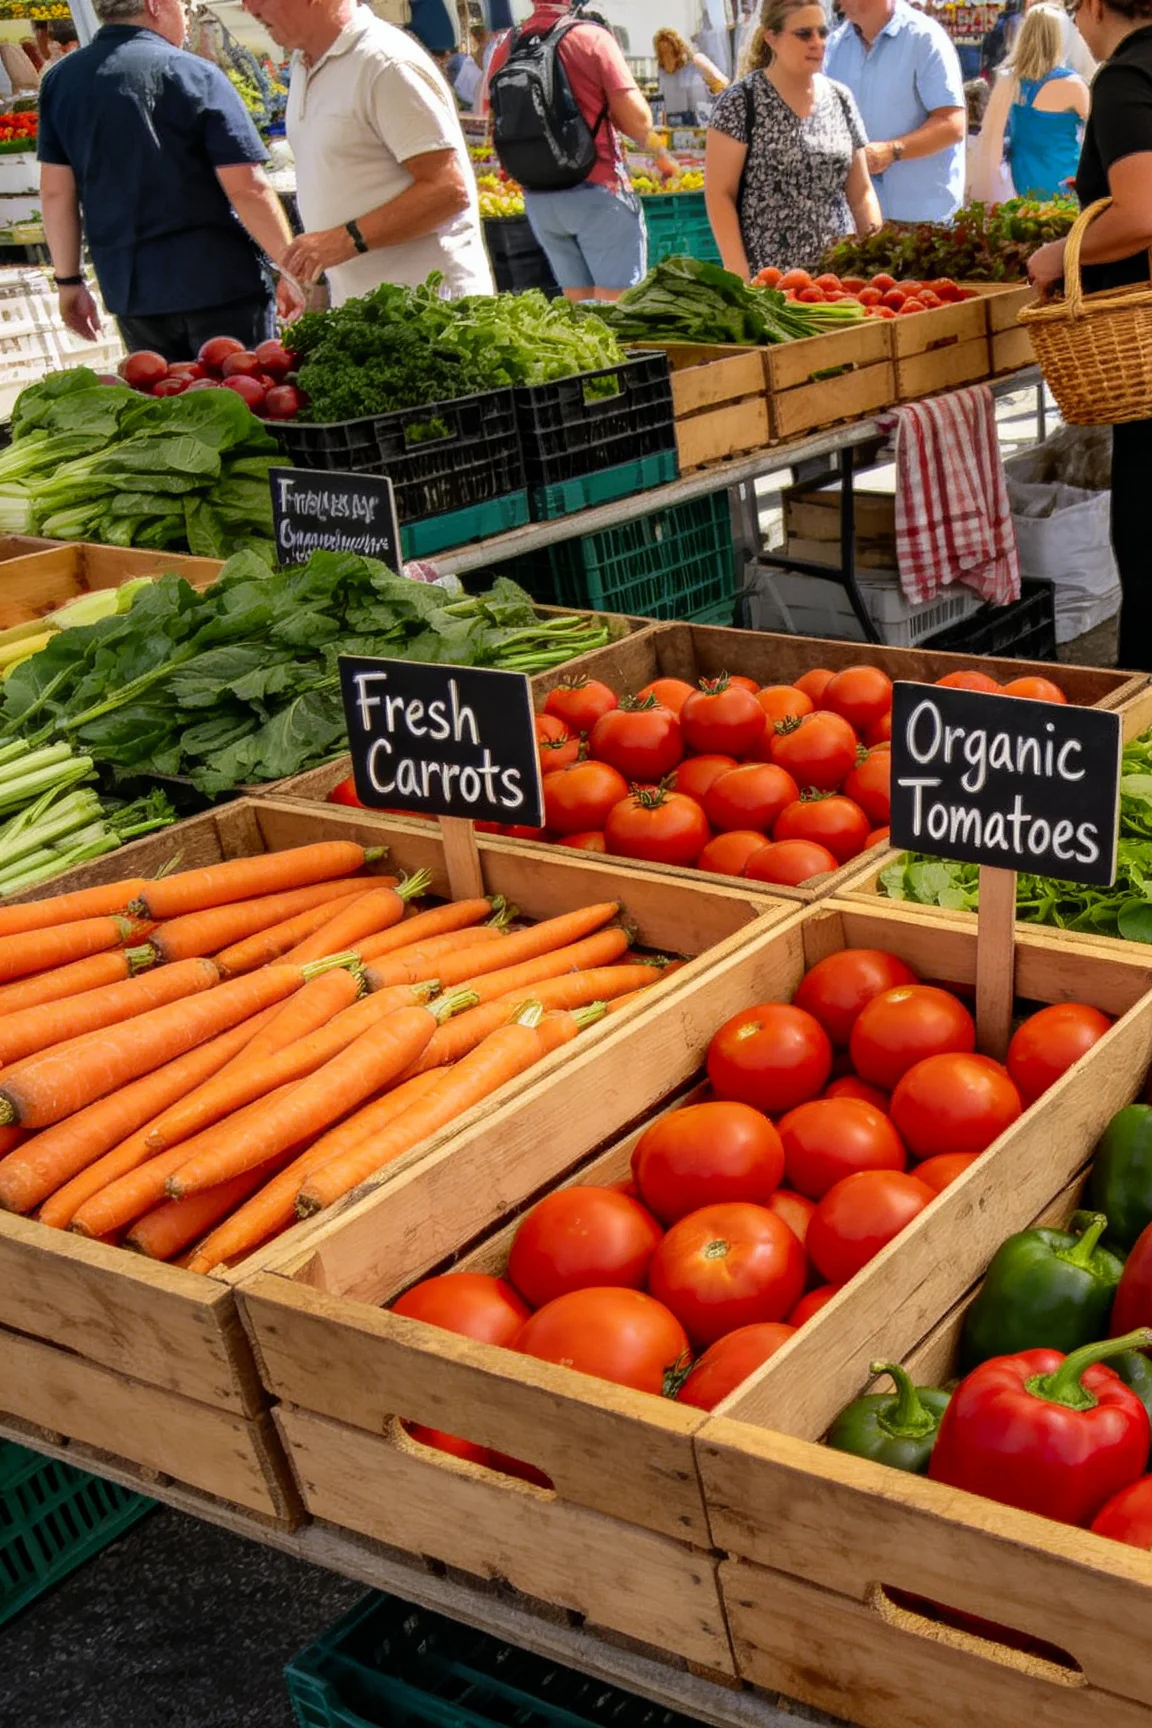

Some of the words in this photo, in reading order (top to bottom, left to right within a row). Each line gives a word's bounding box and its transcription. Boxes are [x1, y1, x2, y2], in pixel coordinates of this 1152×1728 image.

[353, 671, 479, 745] Fresh
[905, 699, 1086, 791] Organic
[368, 738, 525, 809] Carrots
[897, 778, 1099, 864] Tomatoes
